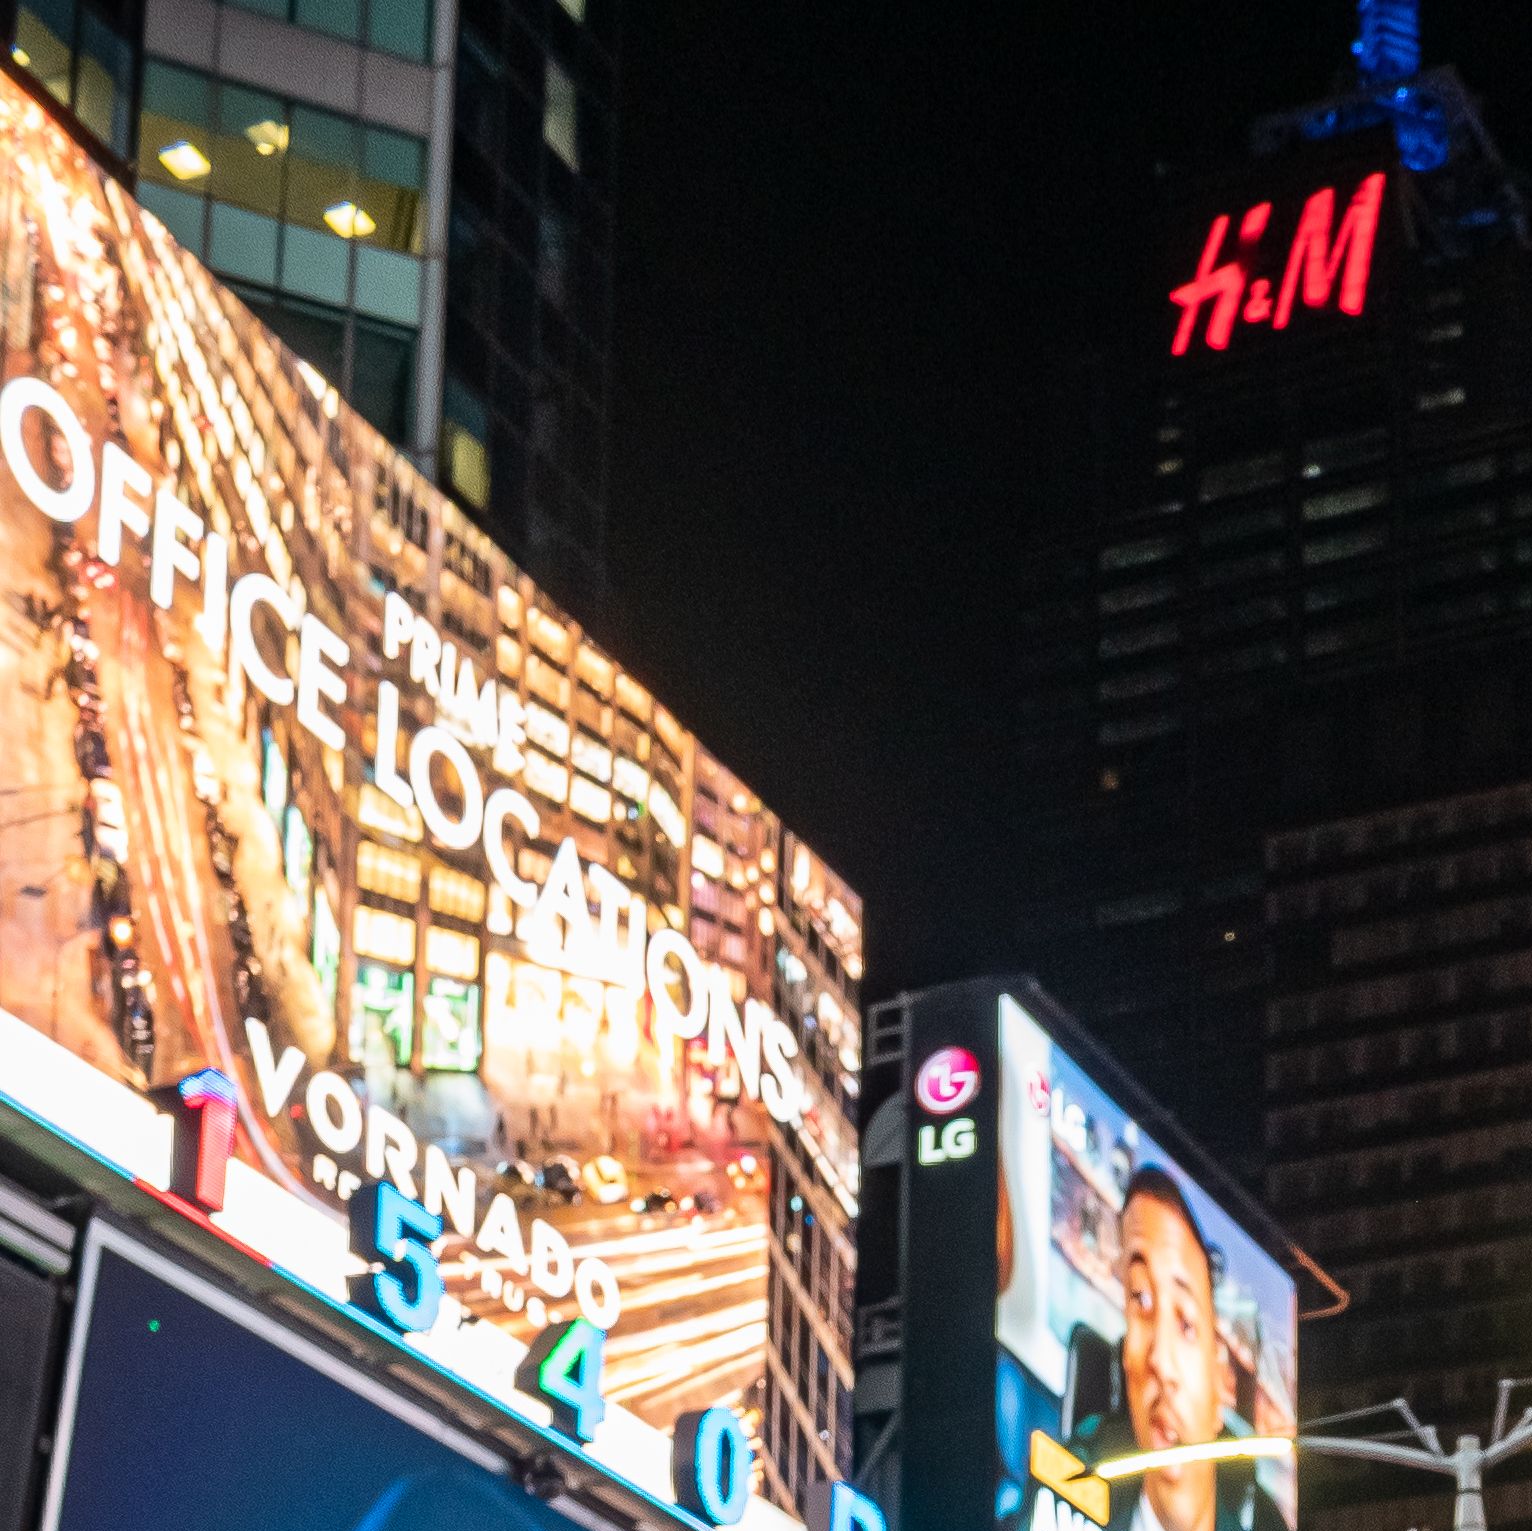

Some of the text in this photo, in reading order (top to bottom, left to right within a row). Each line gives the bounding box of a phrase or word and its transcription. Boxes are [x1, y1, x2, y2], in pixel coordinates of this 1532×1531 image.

[1169, 170, 1386, 356] H&M
[0, 375, 350, 751] OFFICE
[383, 591, 527, 775] PRIME
[375, 680, 800, 1124] LOCATIONS
[245, 1016, 622, 1330] VORNADO
[917, 1116, 978, 1167] LG
